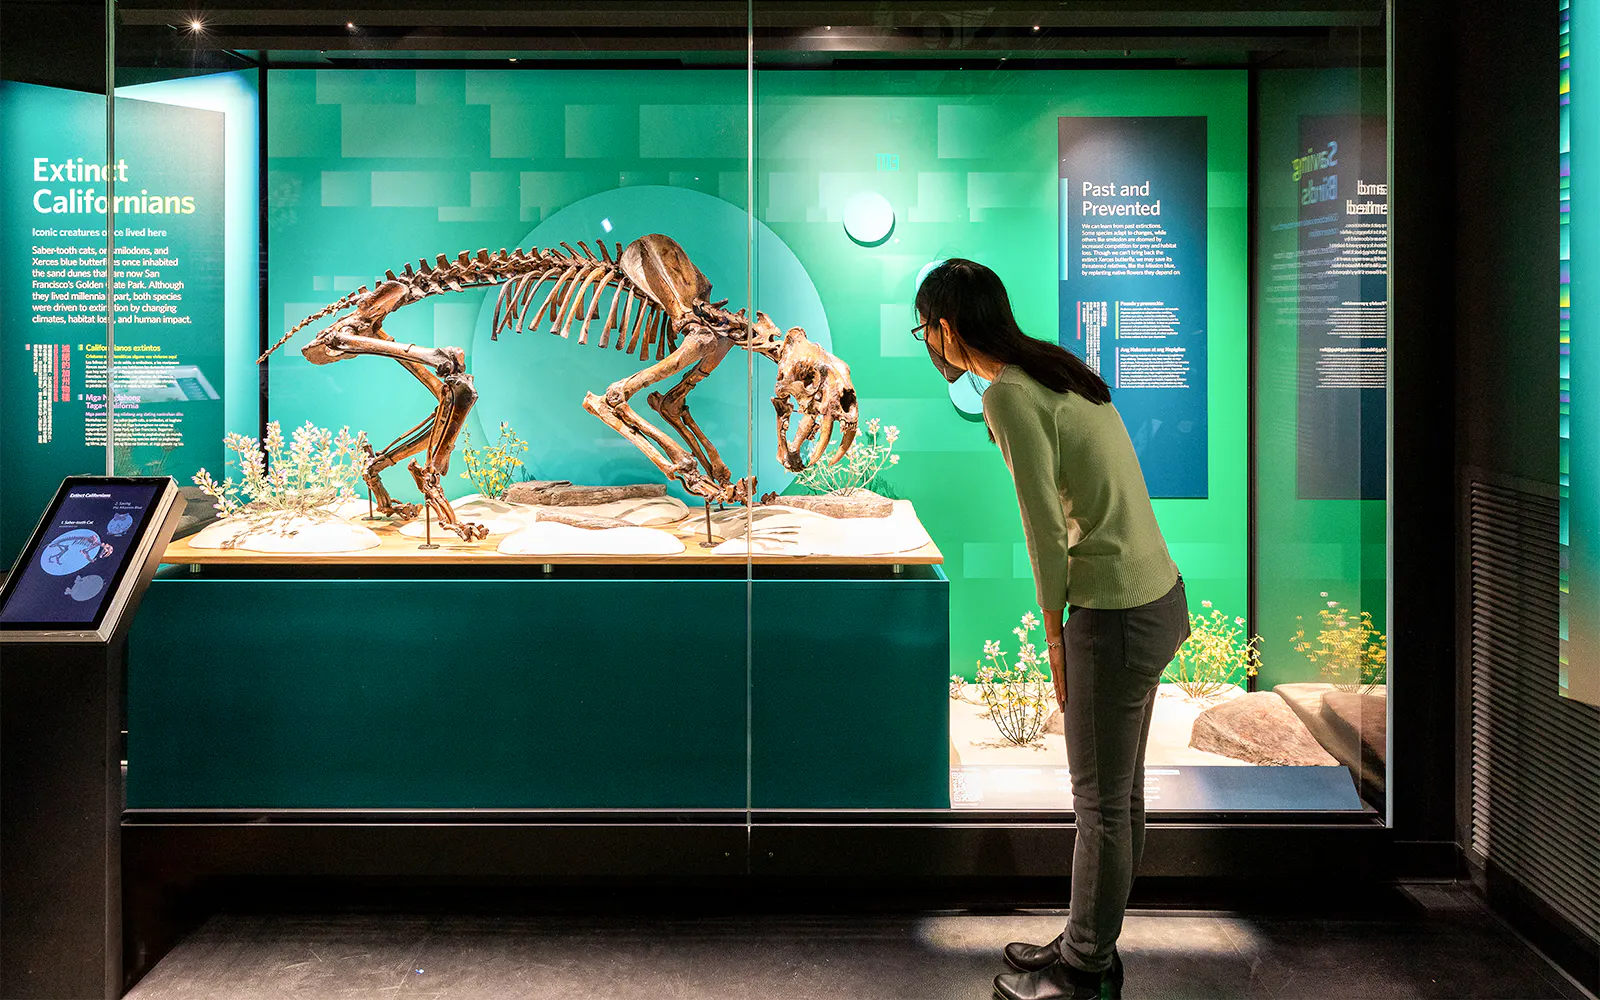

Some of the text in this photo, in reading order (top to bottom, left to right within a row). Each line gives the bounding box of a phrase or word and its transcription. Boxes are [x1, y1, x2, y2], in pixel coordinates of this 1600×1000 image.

[1083, 181, 1150, 196] Past and
[32, 188, 196, 214] Californians
[1082, 200, 1160, 216] Prevented
[32, 228, 57, 236] Iconic
[60, 228, 100, 236] creatures
[126, 228, 145, 236] lived
[148, 228, 167, 236] here
[32, 246, 77, 254] Saber-tooth
[79, 247, 97, 255] cats,
[154, 246, 168, 254] and
[32, 258, 59, 266] Xerces
[60, 258, 77, 266] blue
[142, 258, 178, 266] inhabited
[32, 269, 45, 277] the
[47, 269, 65, 277] sand
[68, 269, 91, 277] dunes
[145, 269, 160, 277] San
[148, 281, 184, 290] Although
[32, 292, 49, 301] they
[110, 292, 131, 301] part,
[153, 292, 182, 302] species
[130, 304, 140, 313] by
[142, 304, 177, 313] changing
[32, 314, 66, 324] climates,
[68, 314, 95, 323] habitat
[118, 314, 132, 323] and
[134, 314, 161, 323] human
[163, 314, 192, 324] impact.
